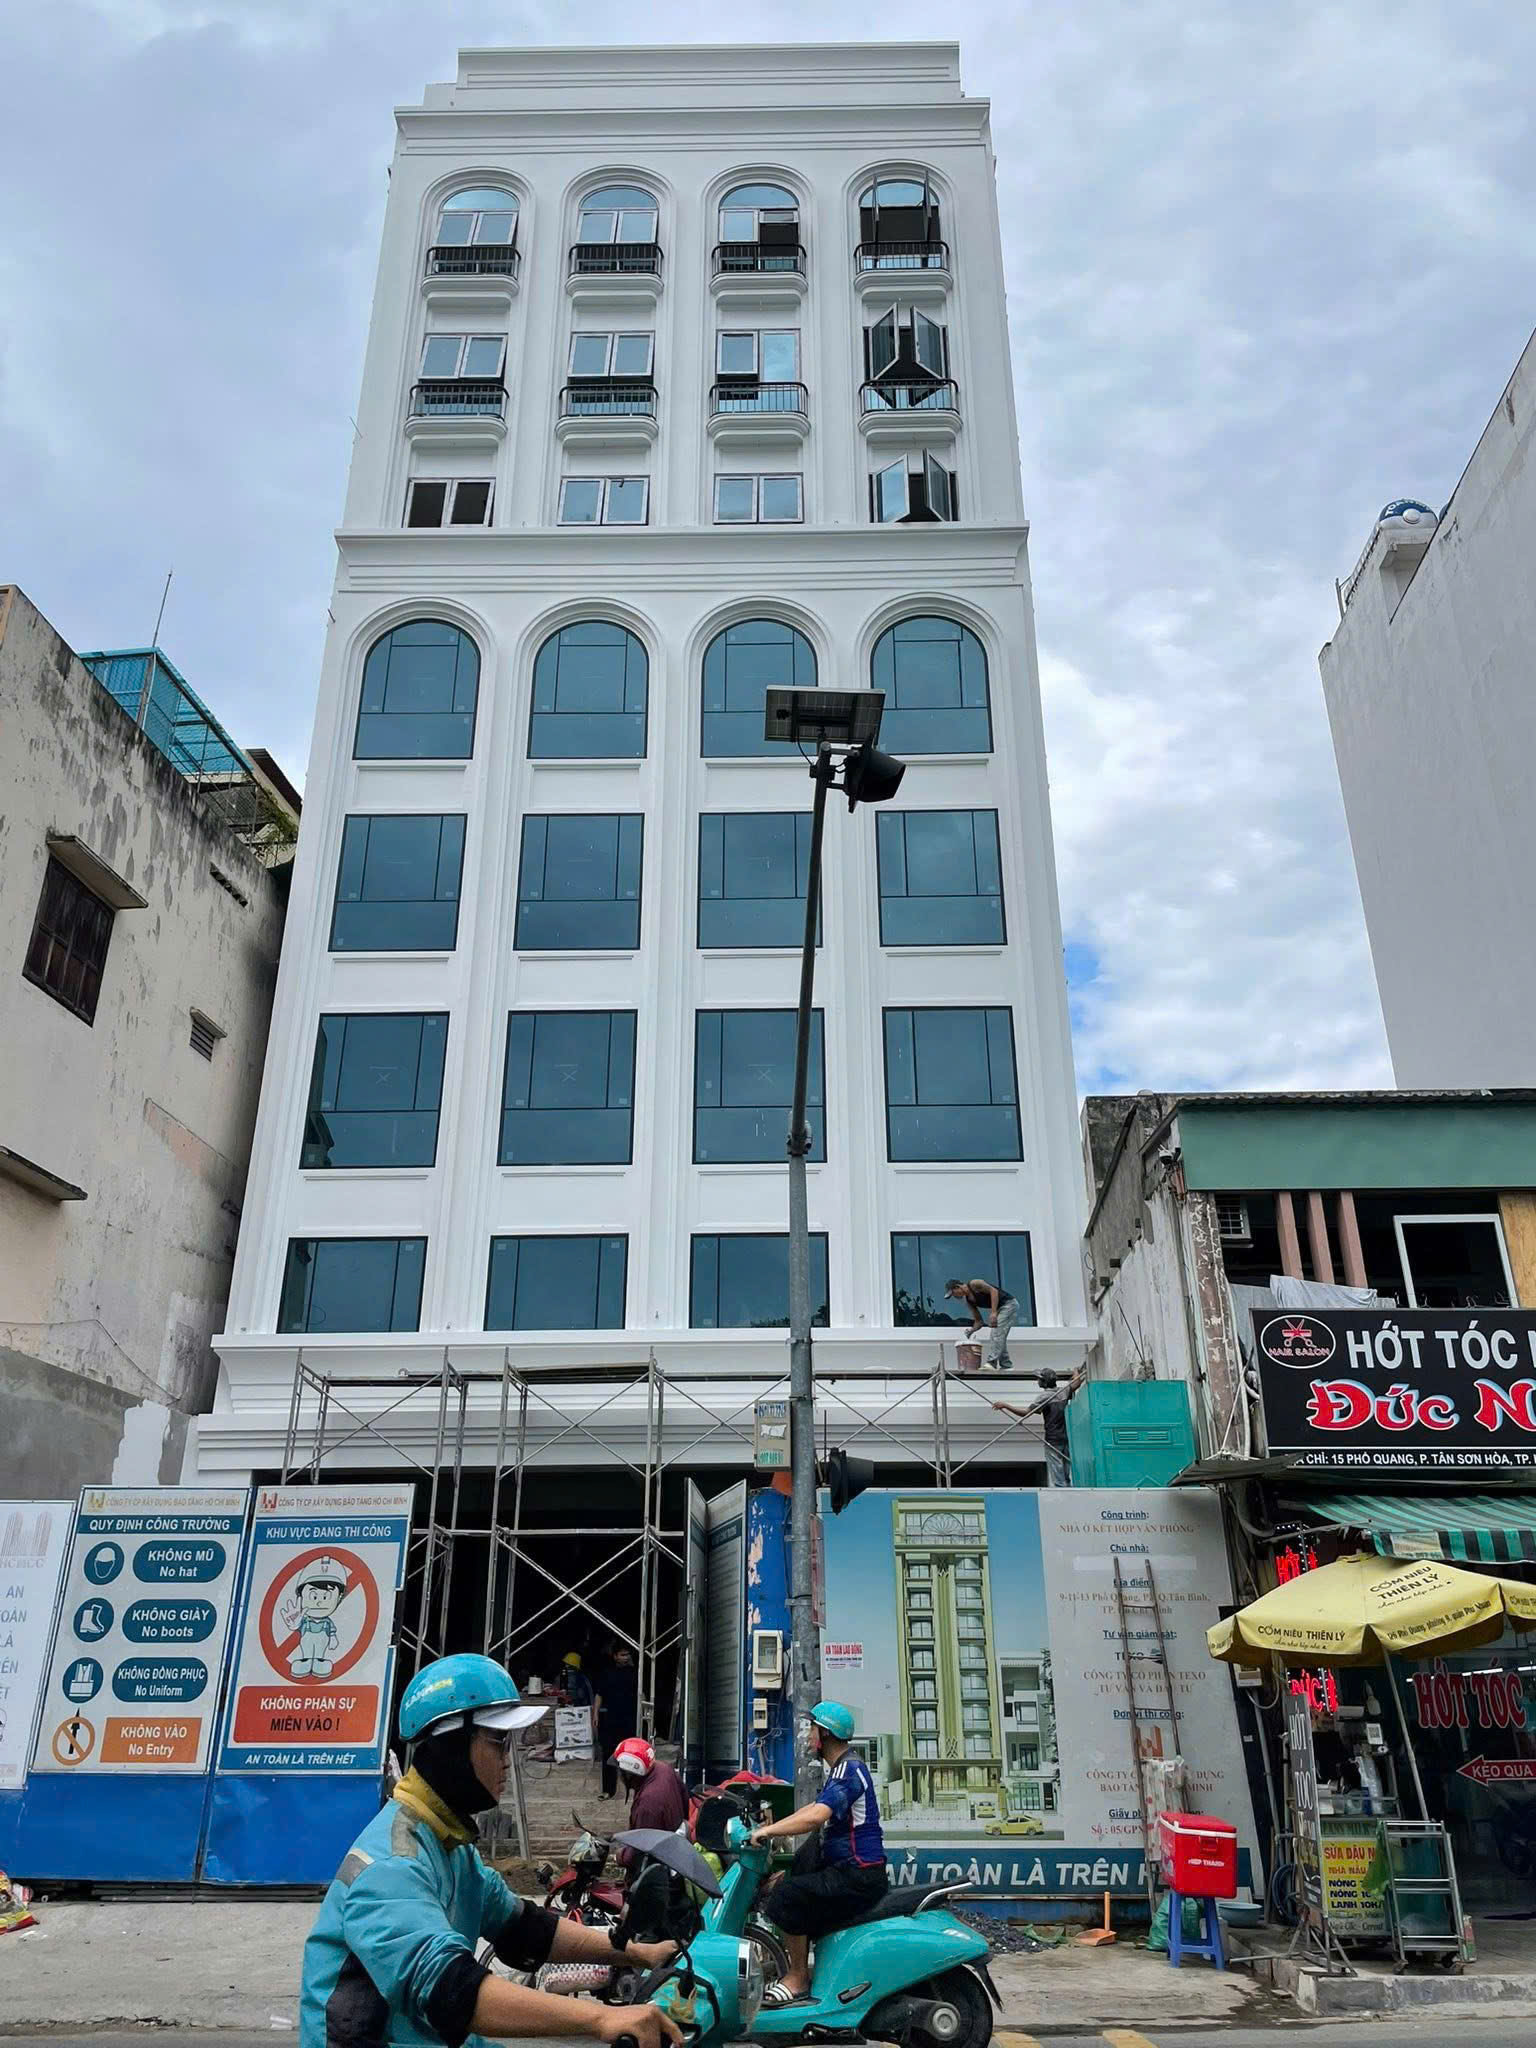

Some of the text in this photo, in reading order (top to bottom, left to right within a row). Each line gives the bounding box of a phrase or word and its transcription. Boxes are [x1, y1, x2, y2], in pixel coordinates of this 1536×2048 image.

[1346, 1320, 1424, 1369] HỚT
[1434, 1320, 1518, 1369] TÓC
[1295, 1347, 1330, 1357] SALON
[1306, 1378, 1459, 1432] Đức
[1331, 1454, 1345, 1464] 15
[1373, 1453, 1418, 1466] QUANG,
[1420, 1454, 1430, 1464] P.
[1431, 1451, 1455, 1464] TÂN
[1457, 1453, 1483, 1465] SƠN
[1484, 1451, 1513, 1466] HÒA,
[1514, 1454, 1532, 1464] TP.
[1101, 1510, 1123, 1520] Công
[89, 1517, 230, 1532] QUY ĐỊNH CÔNG TRƯỜNG
[266, 1524, 392, 1540] KHU VỰC ĐANG THI CÔNG
[148, 1548, 214, 1561] KHÔNG MŨ
[1129, 1544, 1149, 1553] nhà:
[159, 1566, 197, 1577] No hat
[6, 1585, 25, 1598] AN
[132, 1607, 210, 1621] KHÔNG GIÀY
[142, 1626, 194, 1637] No boots
[118, 1666, 150, 1679] KHÔNG
[180, 1667, 205, 1682] PHỤC
[135, 1685, 183, 1696] No Uniform
[1412, 1656, 1469, 1728] HỚT
[1471, 1656, 1526, 1728] TÓC
[260, 1695, 302, 1710] KHÔNG
[338, 1697, 357, 1712] SỰ
[305, 1715, 332, 1731] VÀO
[335, 1718, 340, 1731] !
[121, 1723, 187, 1738] KHÔNG VÀO
[128, 1744, 174, 1758] No Entry
[245, 1754, 259, 1764] AN
[263, 1752, 289, 1764] TOÀN
[291, 1752, 304, 1764] LÀ
[308, 1753, 333, 1764] TRÊN
[1504, 1765, 1533, 1777] QUA
[884, 1863, 917, 1885] AN
[926, 1857, 1003, 1886] TOÀN
[1010, 1857, 1044, 1886] LÀ
[1056, 1857, 1129, 1886] TRÊN
